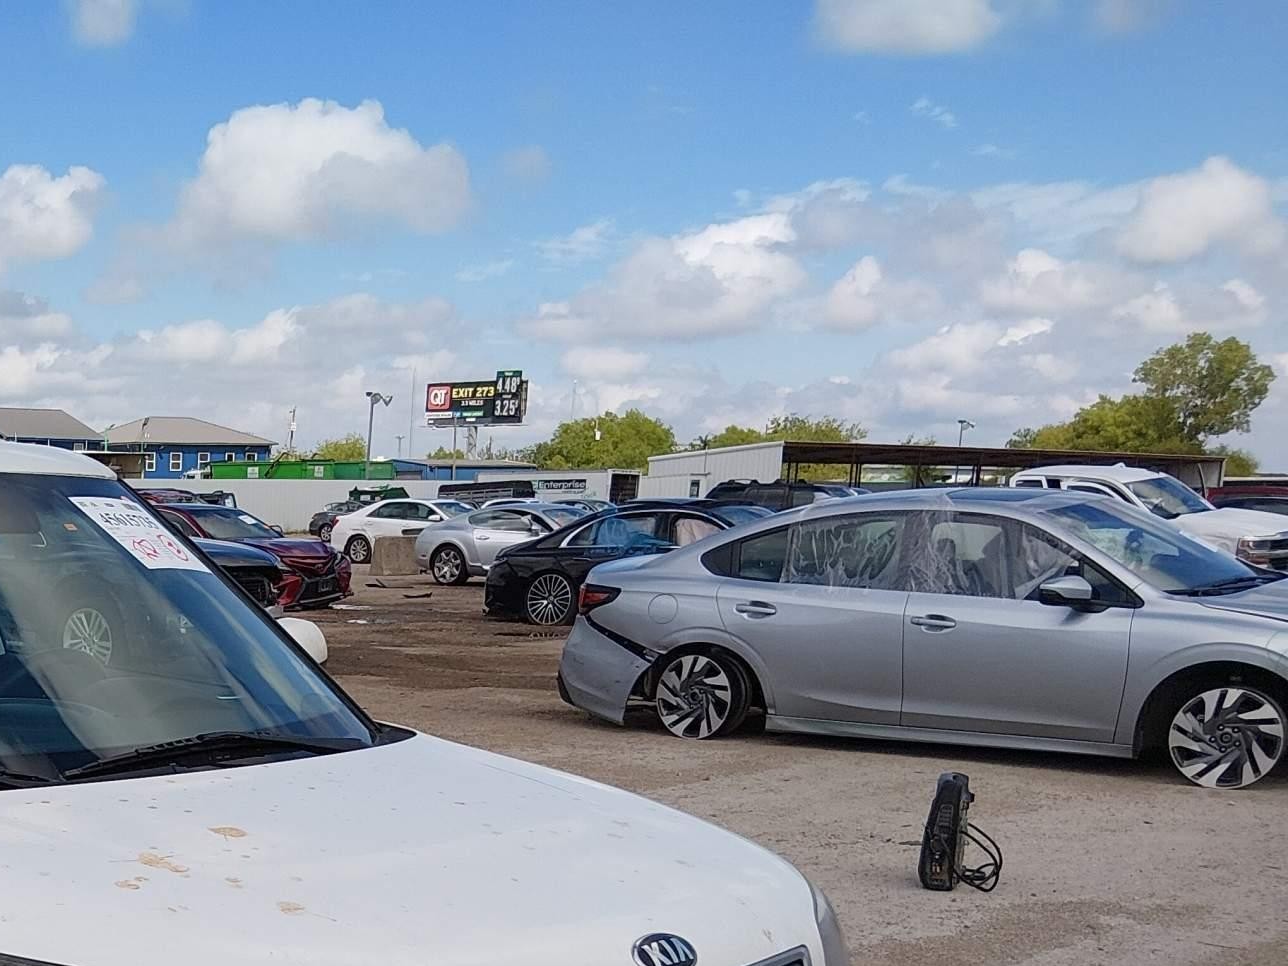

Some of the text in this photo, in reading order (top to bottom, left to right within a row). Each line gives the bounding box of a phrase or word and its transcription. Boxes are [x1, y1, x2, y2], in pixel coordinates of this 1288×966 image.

[430, 389, 447, 406] QT
[452, 386, 494, 398] EXIT 273
[538, 479, 586, 490] Enterprise
[99, 513, 160, 530] 45615735
